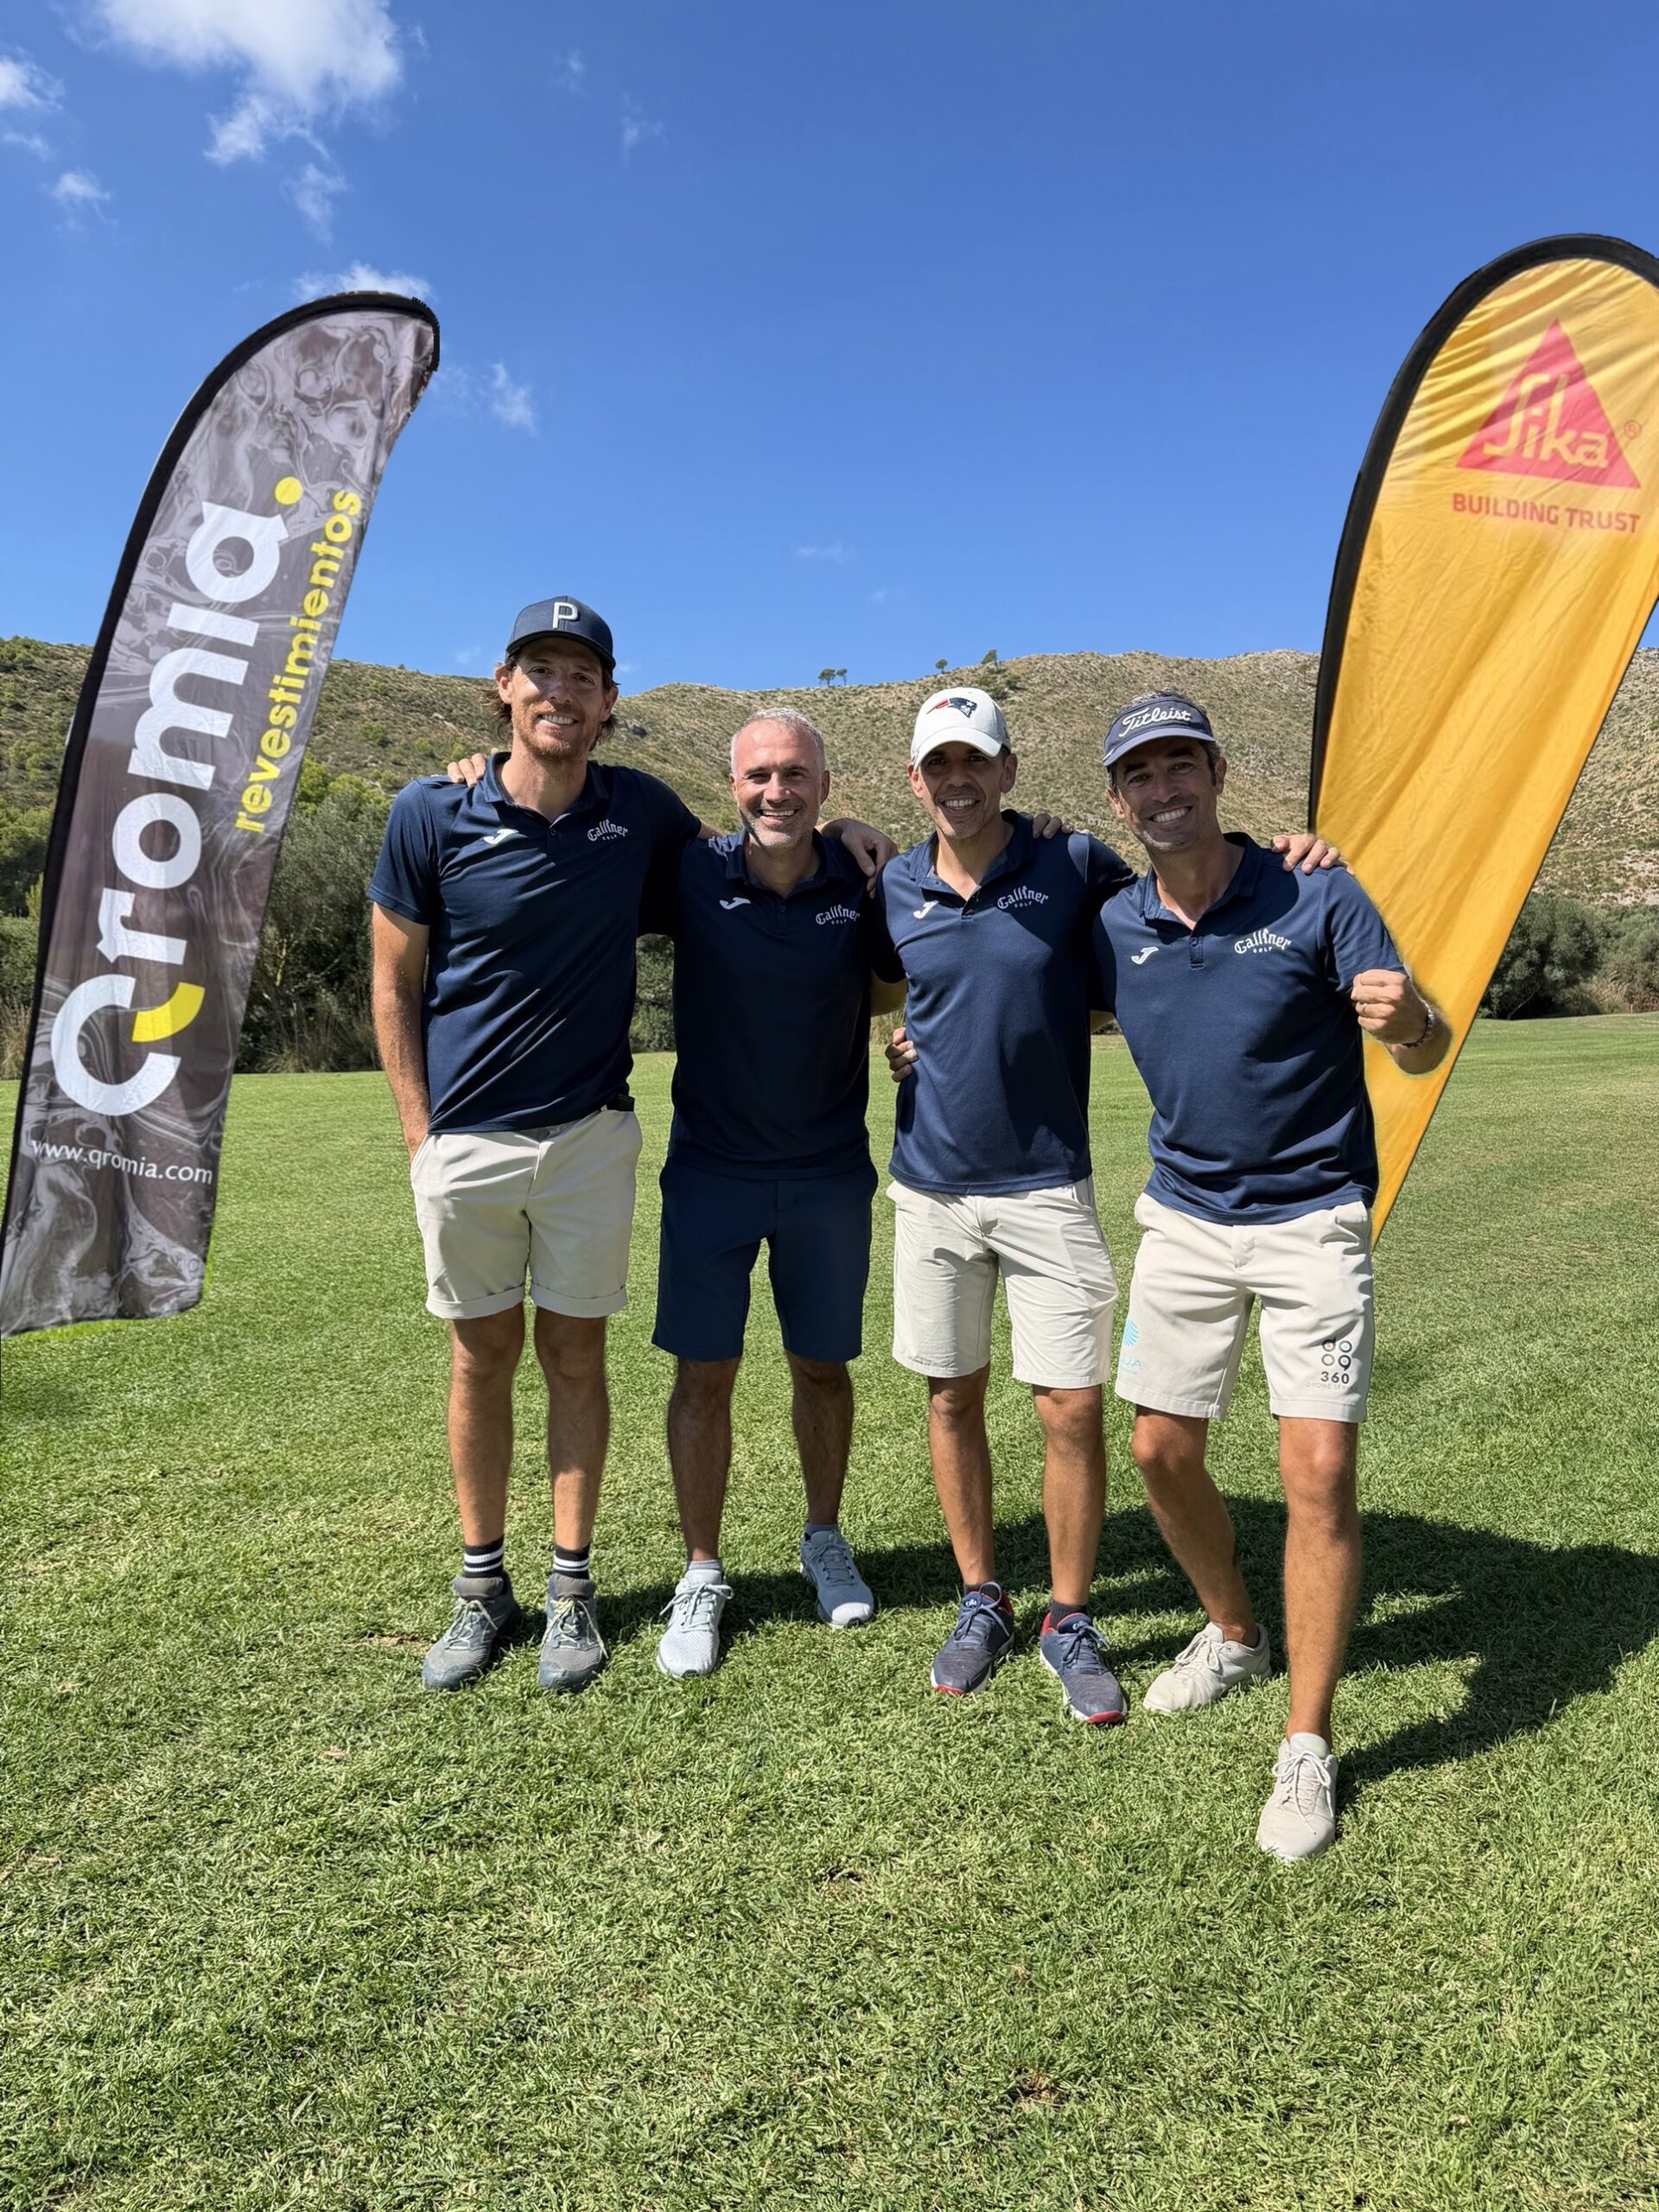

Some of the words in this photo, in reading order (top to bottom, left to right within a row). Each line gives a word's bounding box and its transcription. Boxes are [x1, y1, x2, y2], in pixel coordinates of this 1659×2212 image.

[1483, 372, 1610, 469] Sika
[1452, 493, 1560, 525] BUILDING
[1565, 506, 1641, 533] TRUST
[553, 601, 578, 629] P
[234, 488, 363, 833] revestimientos
[1118, 707, 1191, 738] Titleist
[30, 1140, 213, 1185] www.qromia.com
[1320, 1370, 1350, 1384] 360
